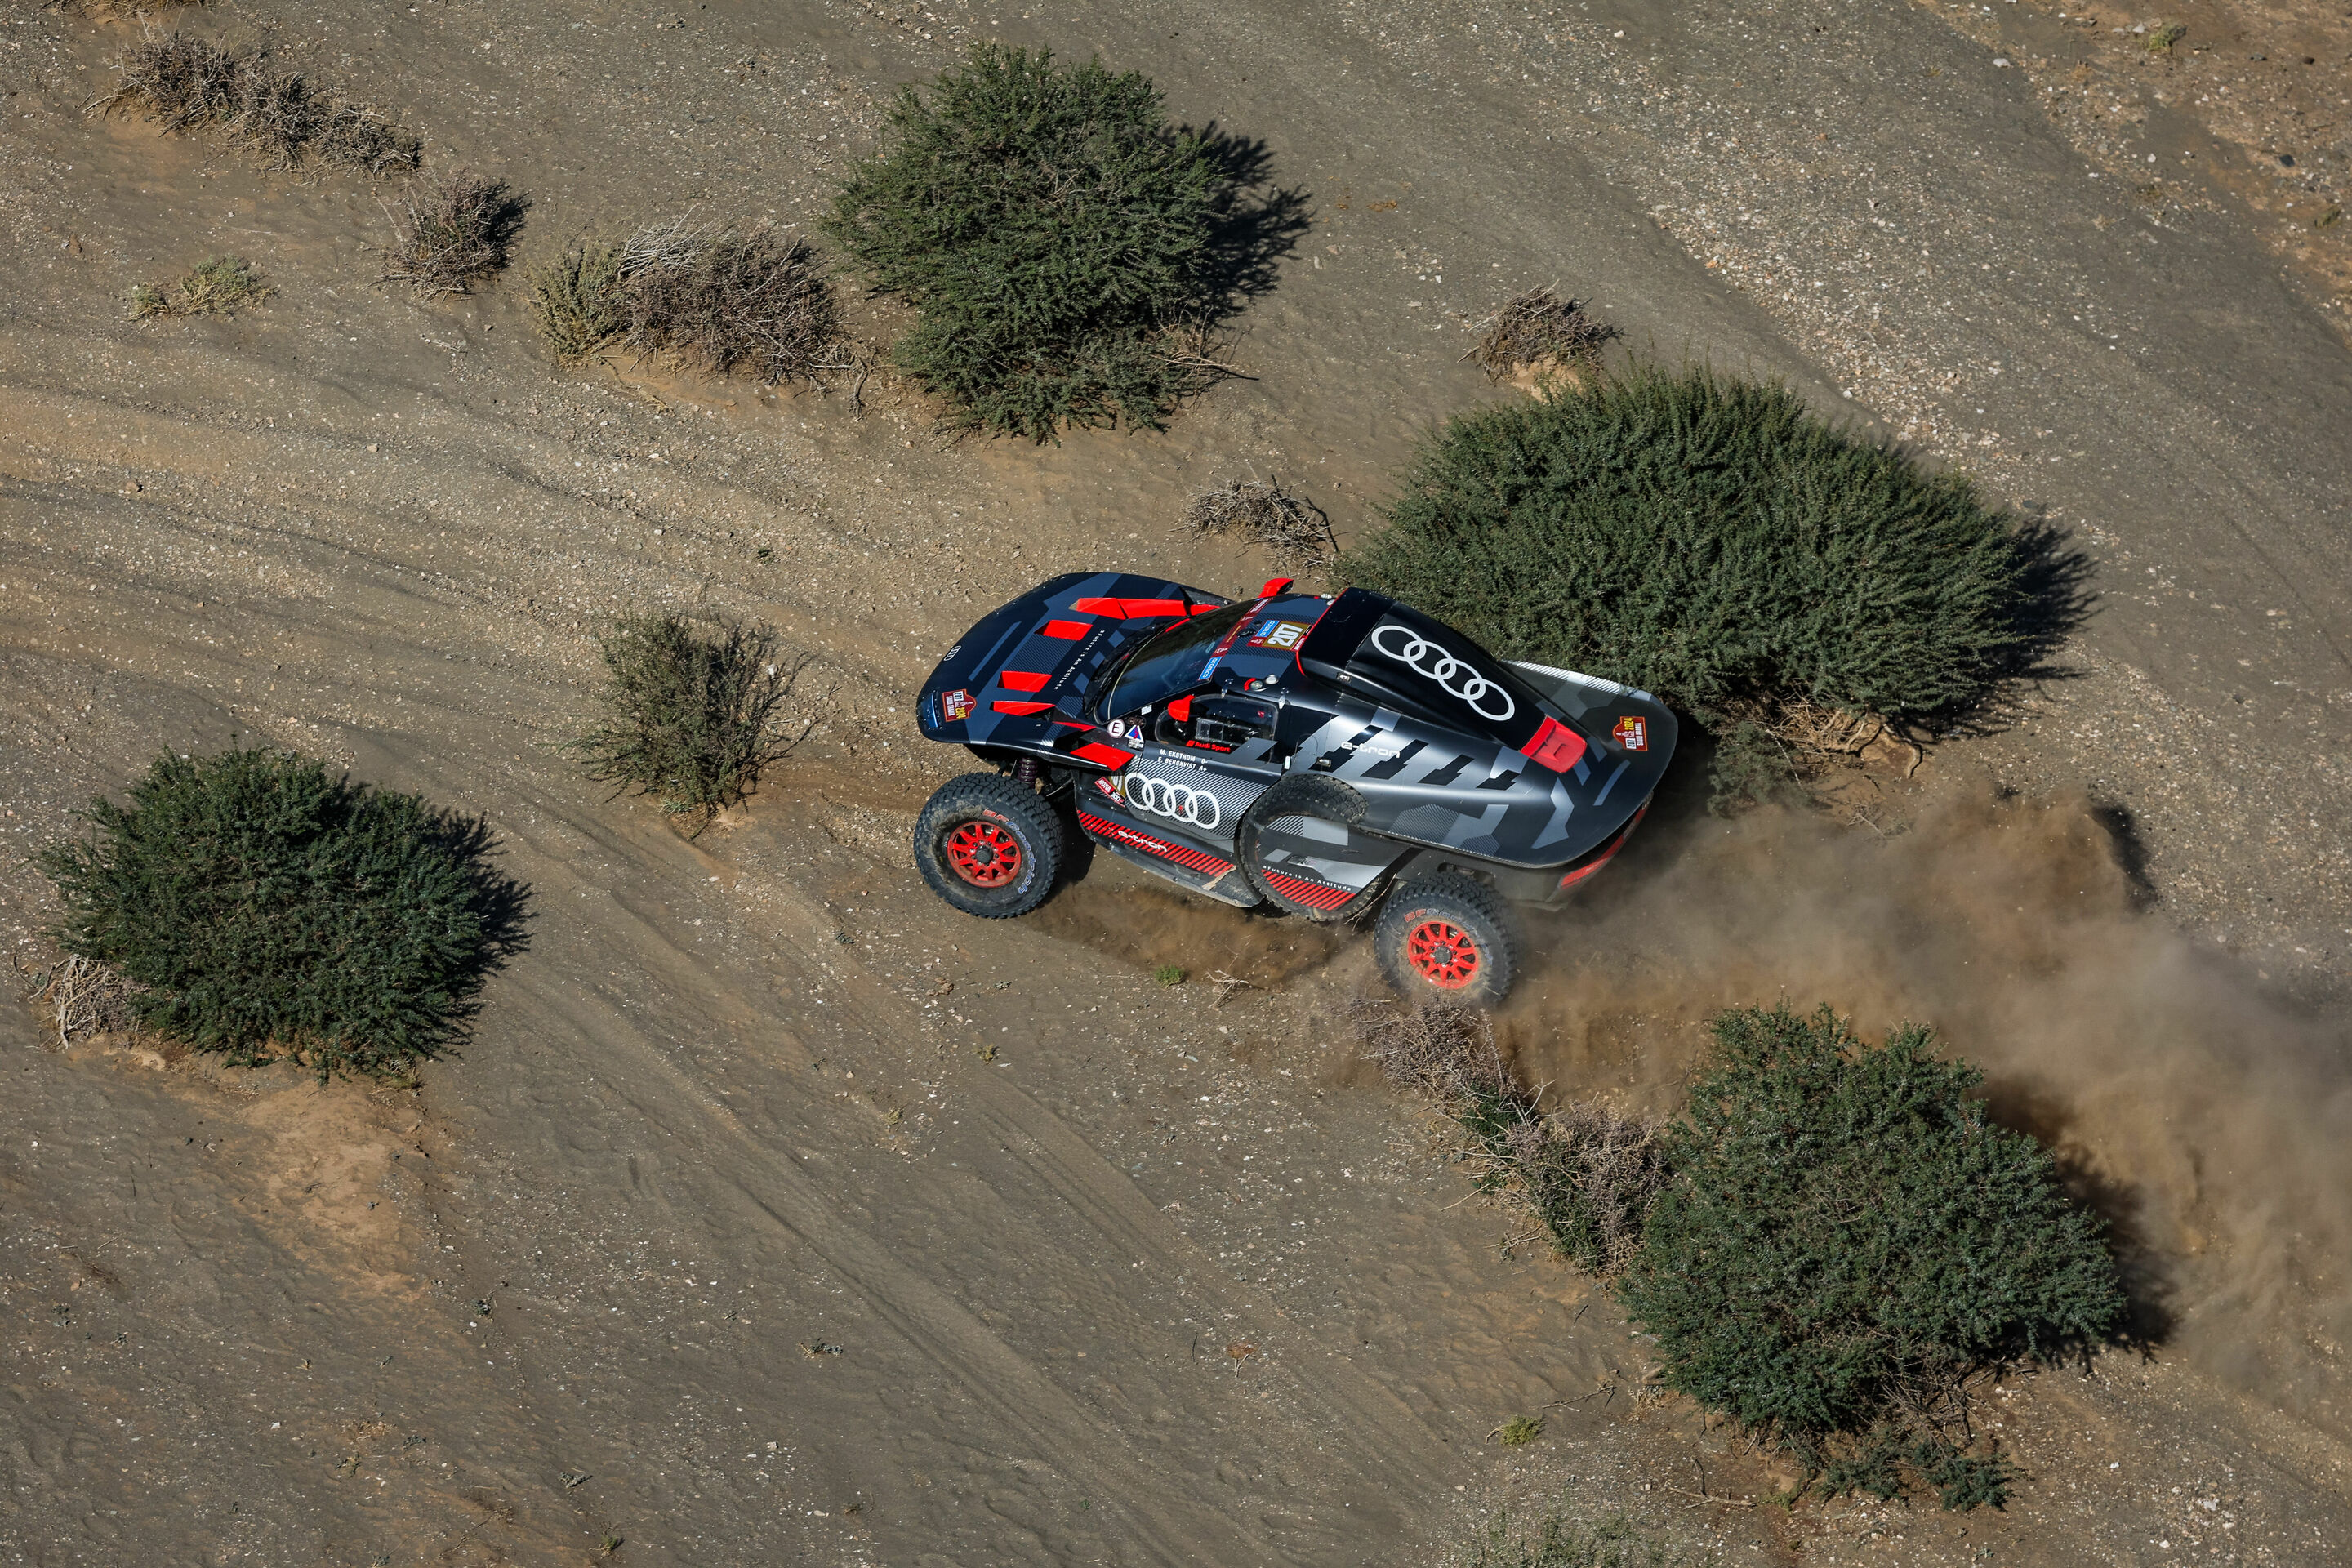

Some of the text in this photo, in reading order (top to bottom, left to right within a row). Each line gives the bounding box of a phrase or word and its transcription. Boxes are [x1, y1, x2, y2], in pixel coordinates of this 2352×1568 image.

[1260, 621, 1276, 636] aramco
[1267, 623, 1304, 647] 207
[1085, 630, 1105, 651] #Future
[1203, 658, 1218, 678] aramco
[1054, 666, 1076, 690] Attitude
[955, 706, 967, 719] 2024
[1111, 722, 1121, 734] E
[1624, 718, 1634, 730] 2024
[1195, 741, 1231, 752] Audi Sport
[1341, 741, 1401, 759] e-tron
[1165, 759, 1197, 768] BERGKVIST
[1098, 779, 1112, 793] MOTUL
[1118, 830, 1168, 853] e-tron
[982, 809, 1036, 894] BFGoodrich
[1263, 865, 1292, 877] #Future
[1317, 880, 1352, 892] Attitude
